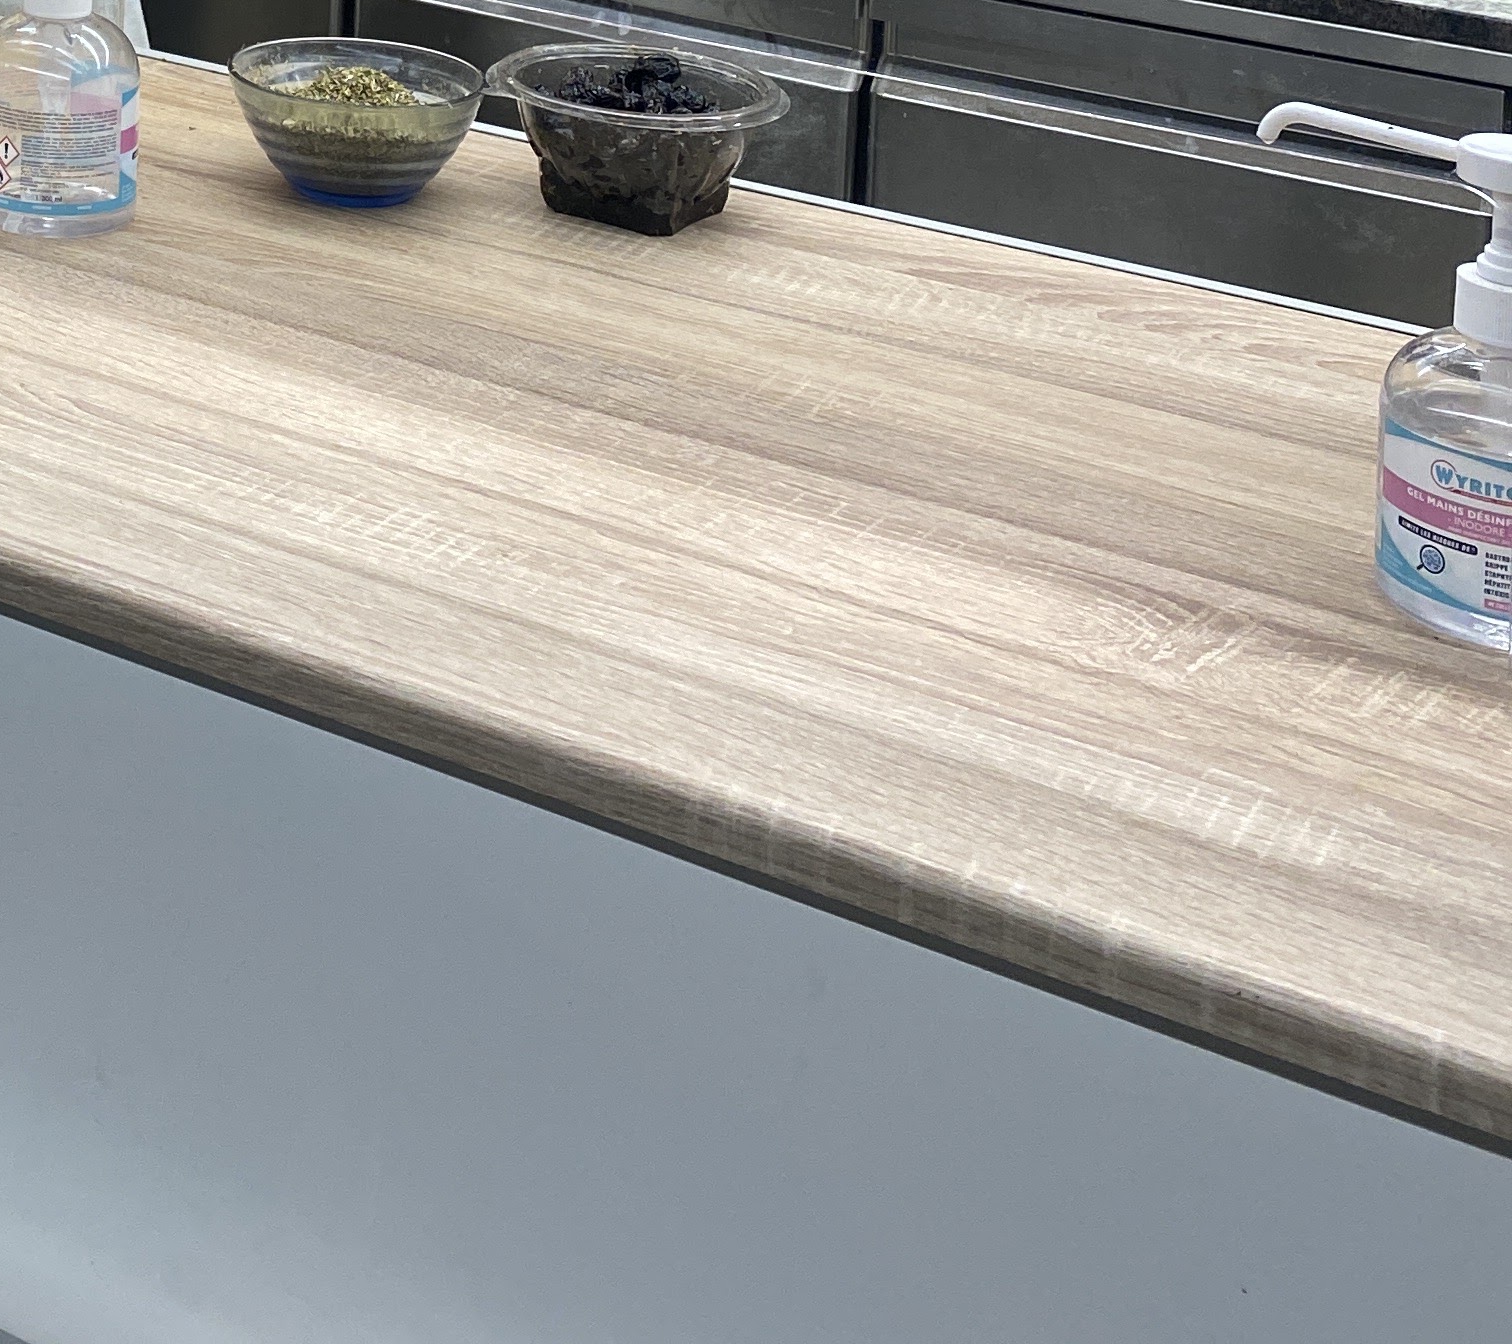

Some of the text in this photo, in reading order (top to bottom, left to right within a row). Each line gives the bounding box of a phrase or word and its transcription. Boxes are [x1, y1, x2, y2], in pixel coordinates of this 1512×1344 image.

[1407, 486, 1425, 502] GEL
[1426, 496, 1464, 516] MAINS
[1454, 517, 1506, 538] INODORE
